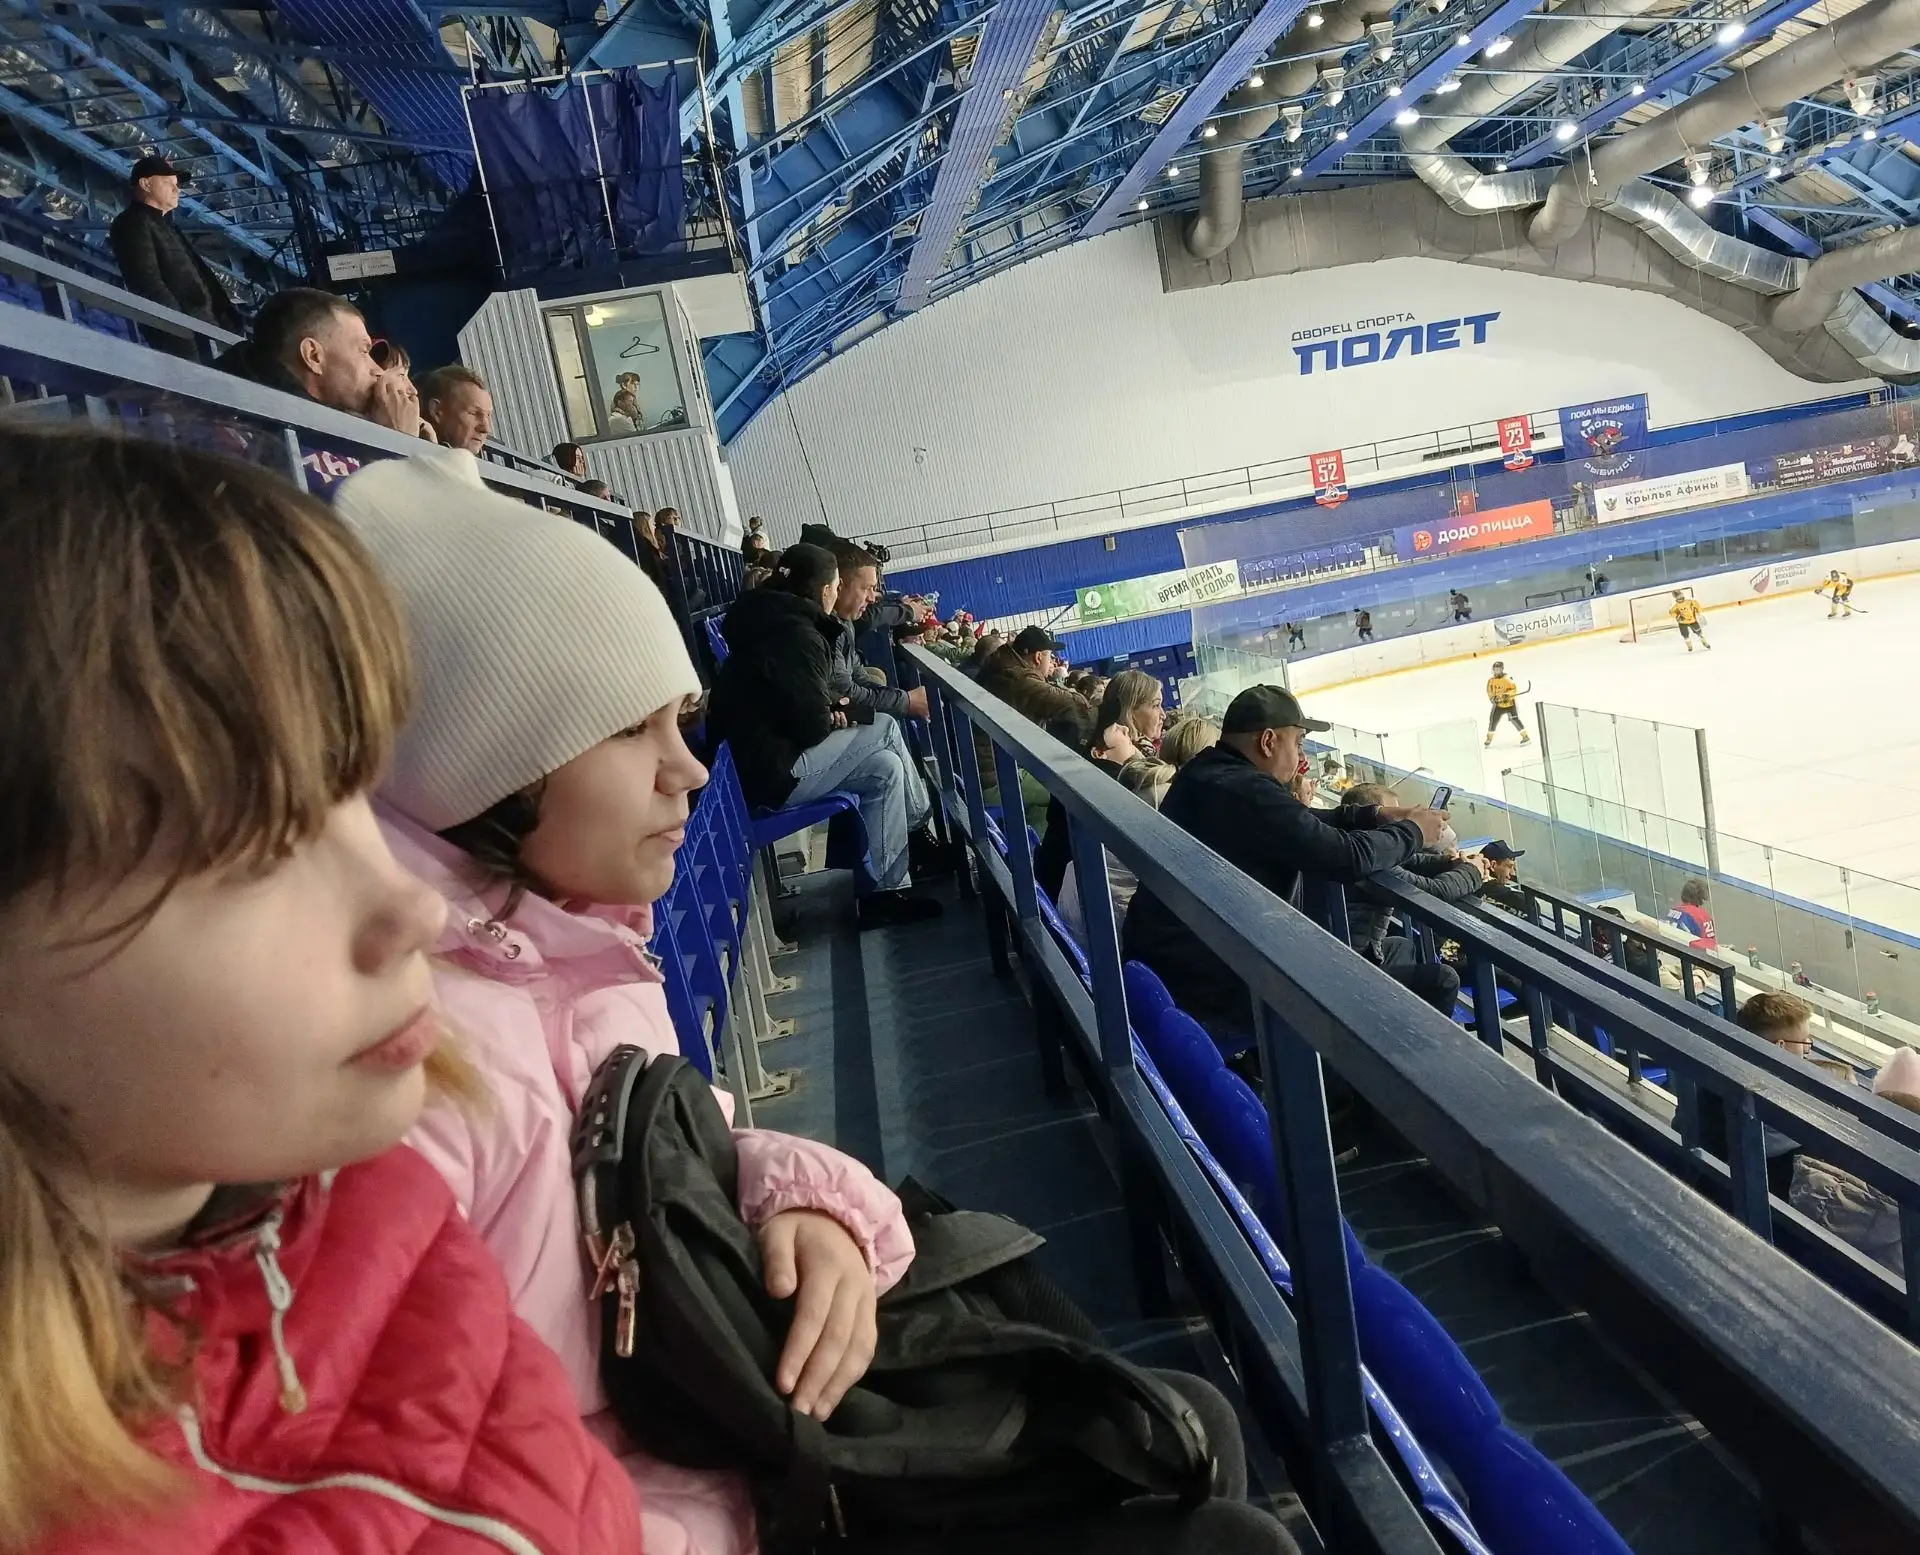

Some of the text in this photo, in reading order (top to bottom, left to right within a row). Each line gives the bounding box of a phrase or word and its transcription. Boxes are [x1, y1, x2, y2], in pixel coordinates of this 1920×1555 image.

[1291, 312, 1416, 342] ДВОРЕЦ СПОРТА
[1292, 311, 1502, 376] ПОЛЕТ
[1570, 403, 1635, 420] ПОКА МЫ ЕДИНЫ
[1505, 427, 1525, 448] 23
[1586, 419, 1624, 434] ПОЛЕТ
[1318, 462, 1339, 483] 52
[1583, 454, 1636, 477] РЫБИНСК
[1625, 490, 1672, 505] Крылья
[1676, 480, 1719, 496] Афины
[1437, 514, 1533, 545] ДОДО ПИЦЦА
[1157, 564, 1223, 603] ВРЕМЯ ИГРАТЬ
[1195, 572, 1236, 600] В ГОЛЬФ
